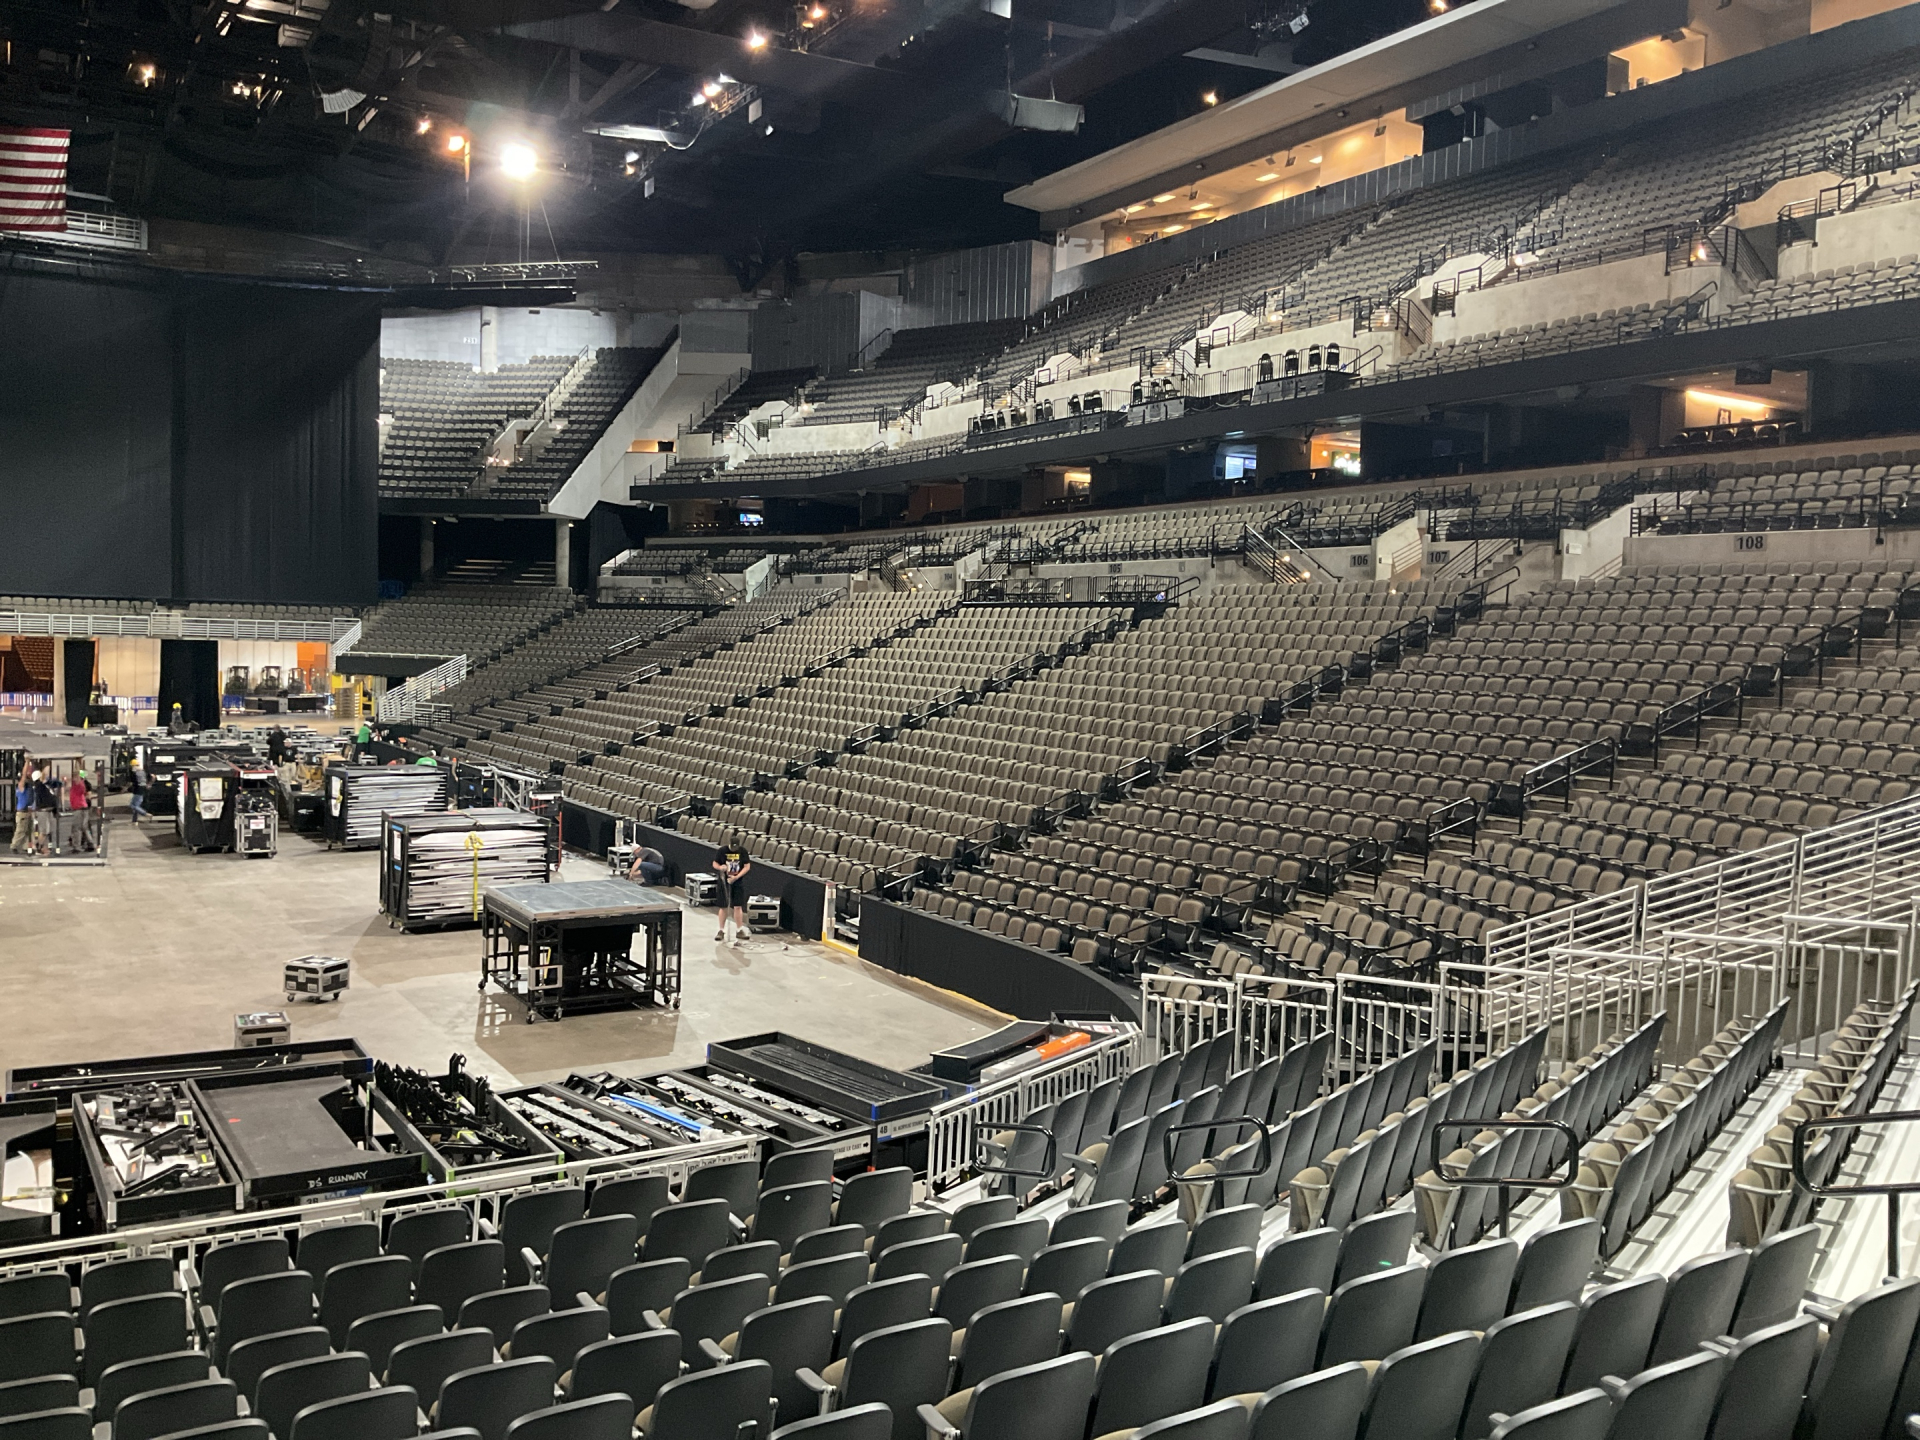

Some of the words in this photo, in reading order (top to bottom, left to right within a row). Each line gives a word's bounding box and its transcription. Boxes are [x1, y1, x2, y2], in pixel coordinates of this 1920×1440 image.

[1736, 535, 1764, 550] 108
[1352, 555, 1368, 566] 106
[1430, 551, 1448, 563] 107
[1109, 563, 1121, 573] 105
[880, 1125, 888, 1134] 4B
[328, 1170, 368, 1184] RUNWAY
